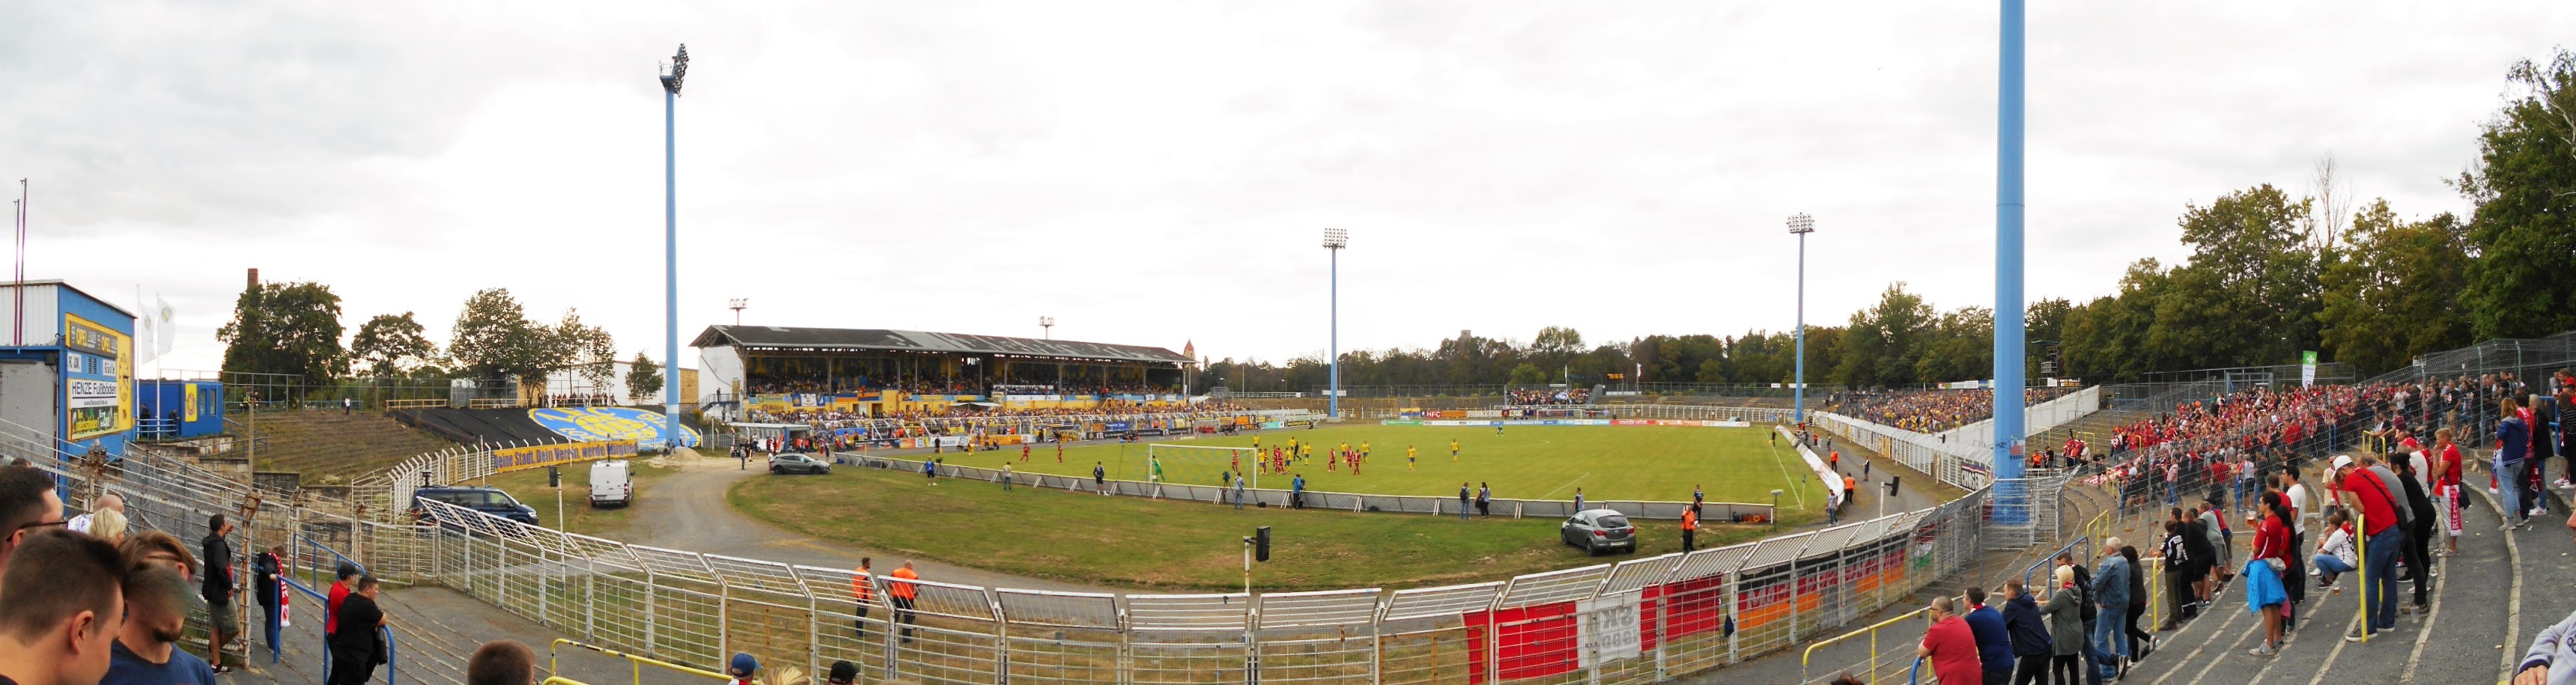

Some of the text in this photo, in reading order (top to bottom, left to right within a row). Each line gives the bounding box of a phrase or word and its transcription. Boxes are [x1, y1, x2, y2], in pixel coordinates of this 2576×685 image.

[76, 328, 88, 347] OPEL
[101, 335, 111, 353] OPEL
[72, 381, 116, 395] HENZE Fußböden
[536, 449, 553, 463] Dein
[581, 445, 605, 457] werde
